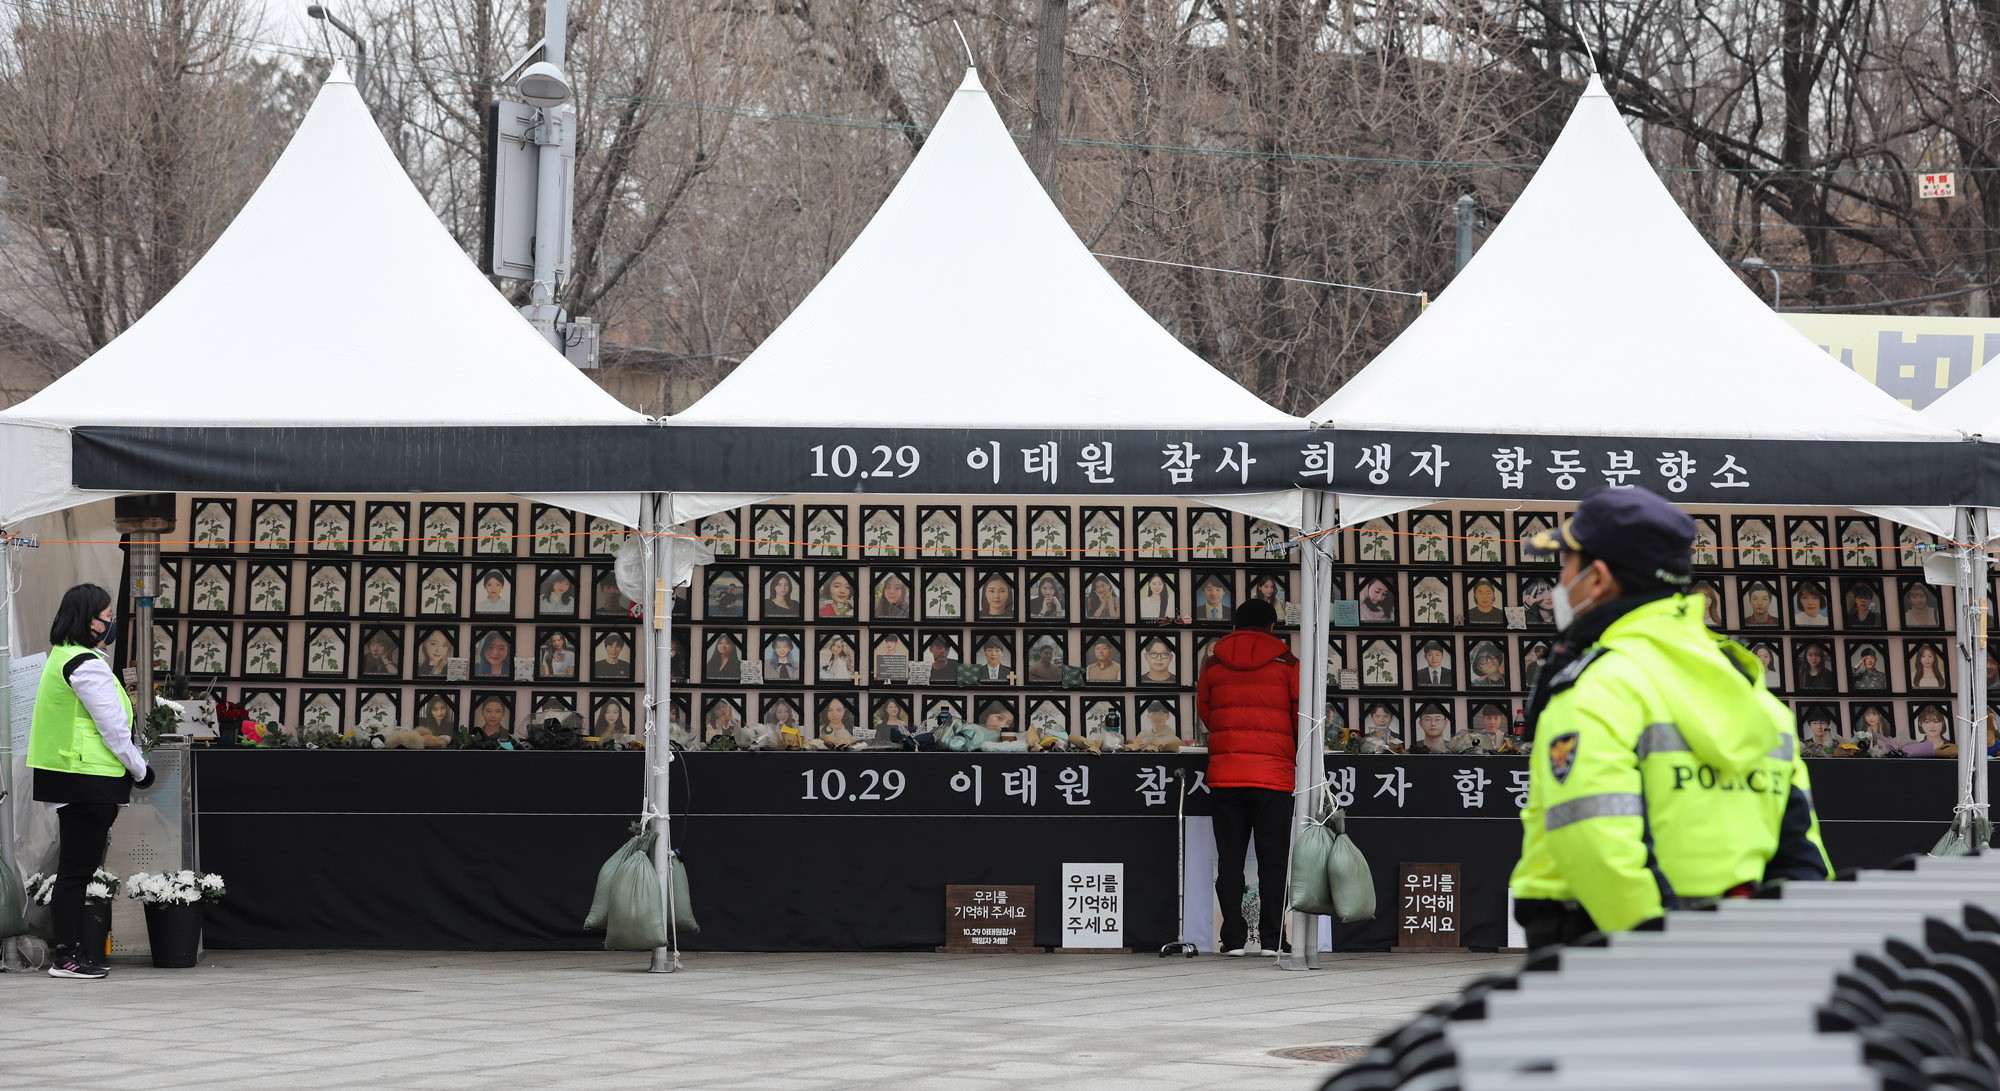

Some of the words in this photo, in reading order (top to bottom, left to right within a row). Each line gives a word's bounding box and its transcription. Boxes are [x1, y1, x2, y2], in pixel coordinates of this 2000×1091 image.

[811, 445, 920, 478] 10.29
[967, 441, 1114, 484] 이태원
[1161, 442, 1256, 484] 참사
[1299, 441, 1450, 487] 희생자
[1492, 447, 1749, 493] 합동분향소
[802, 769, 905, 801] 10.29
[950, 765, 1091, 806] 이태원
[1327, 766, 1412, 807] 생자
[1453, 767, 1530, 809] 합동
[1672, 764, 1782, 795] POLCE
[1068, 875, 1118, 892] 우리를
[1404, 874, 1455, 892] 우리를
[973, 891, 1008, 904] 우리를
[1068, 896, 1118, 913] 기억해
[1404, 895, 1454, 912] 기억해
[954, 906, 988, 919] 기억해
[991, 906, 1026, 919] 주세요
[963, 928, 981, 936] 10.29
[1067, 917, 1118, 934] 주세요
[1403, 916, 1455, 933] 주세요
